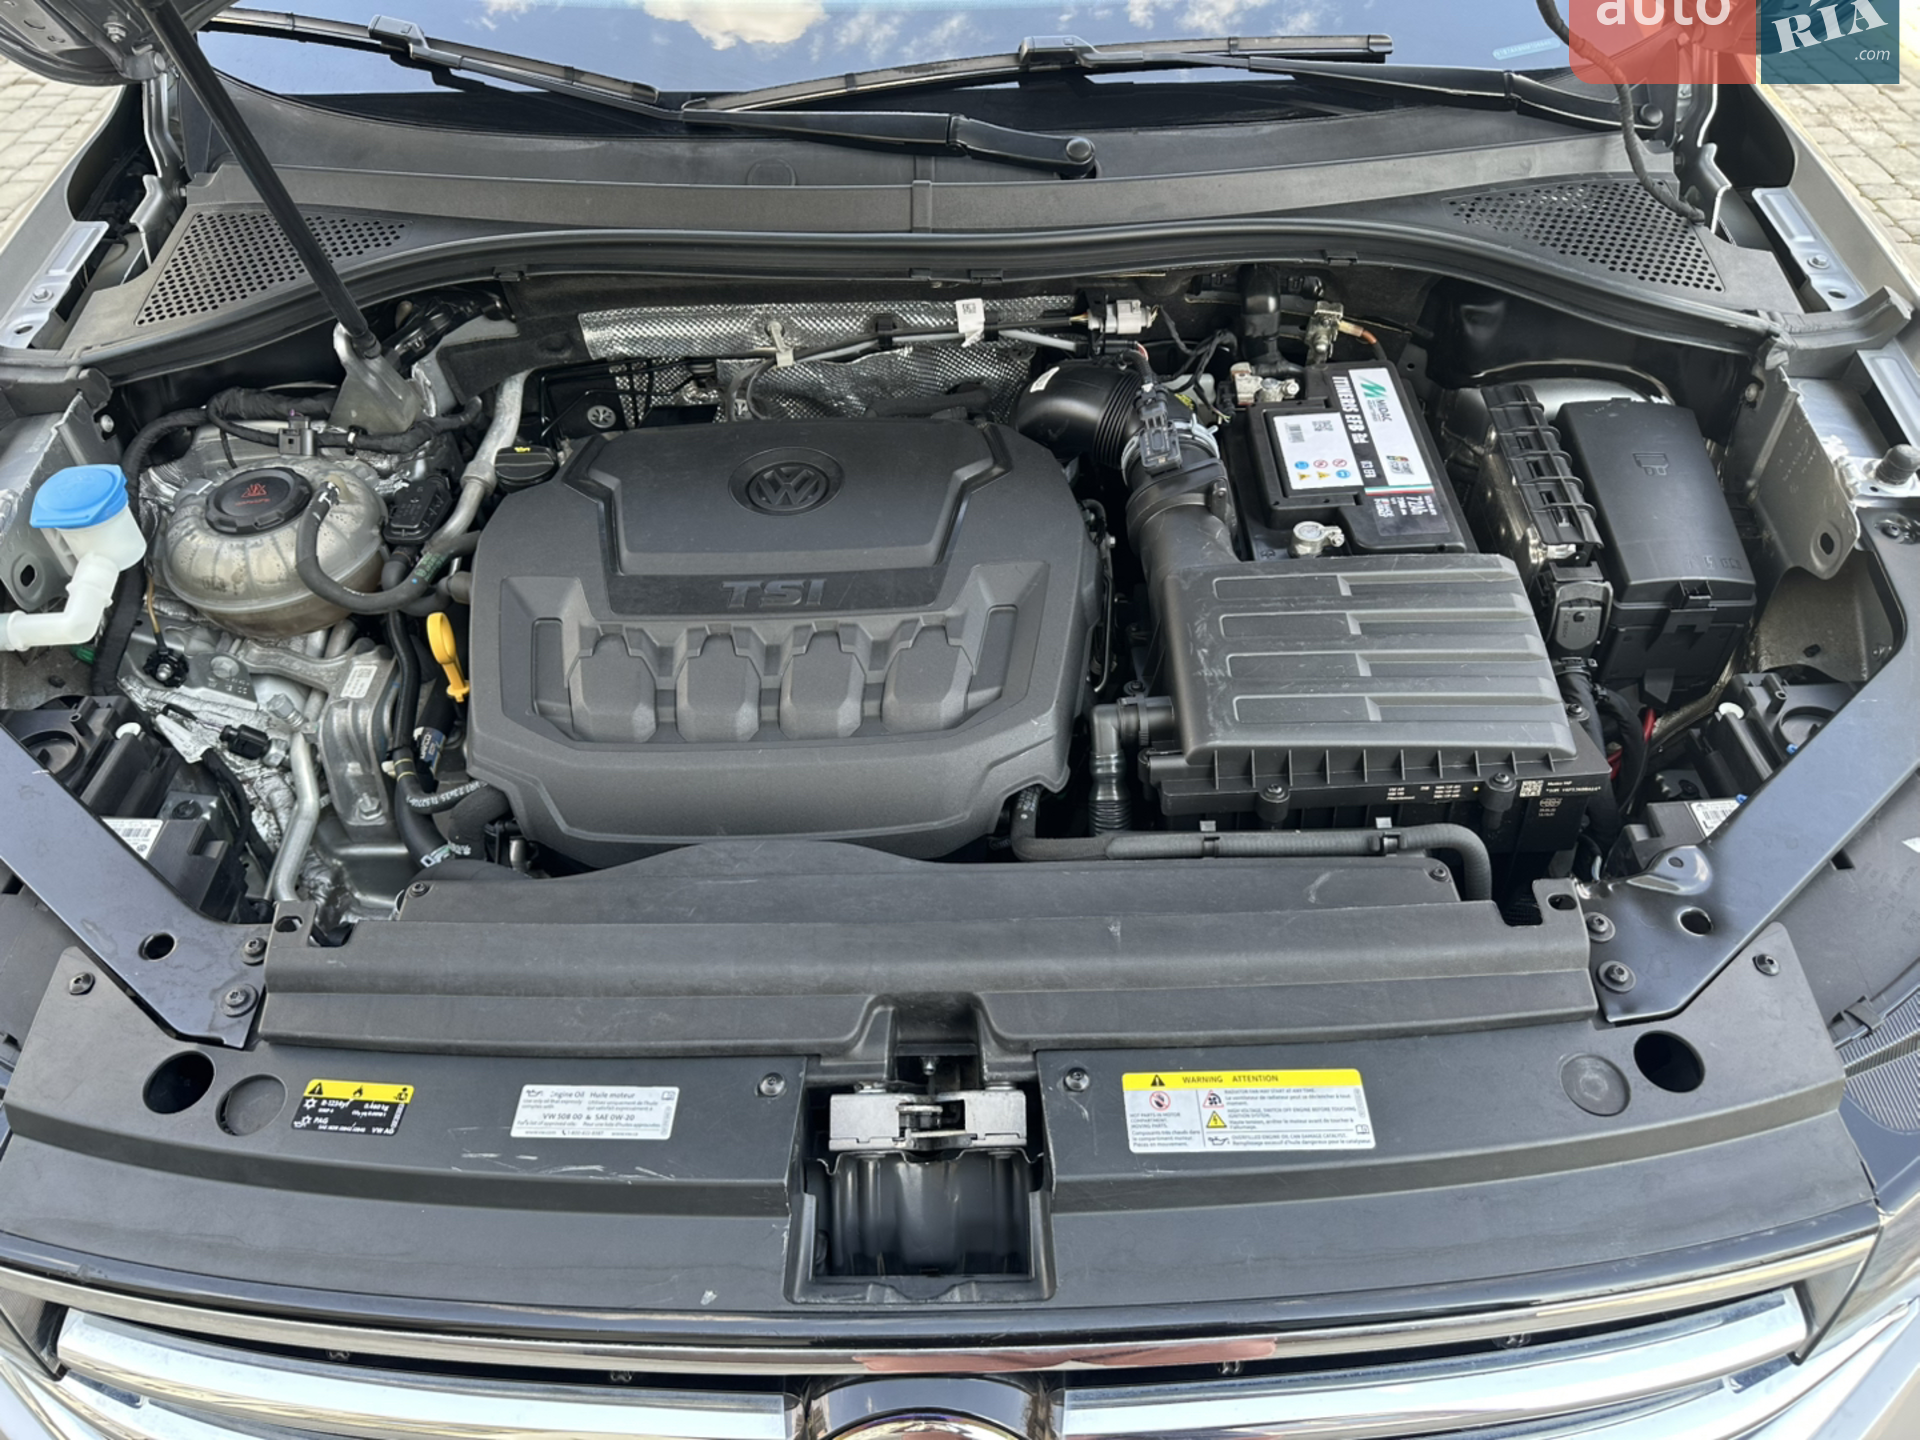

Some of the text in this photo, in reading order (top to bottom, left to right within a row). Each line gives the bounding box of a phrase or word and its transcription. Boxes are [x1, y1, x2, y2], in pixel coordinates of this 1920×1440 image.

[1376, 399, 1392, 422] MIDAC
[722, 578, 827, 608] TSI
[1182, 1075, 1279, 1084] WARNING ATTENTION
